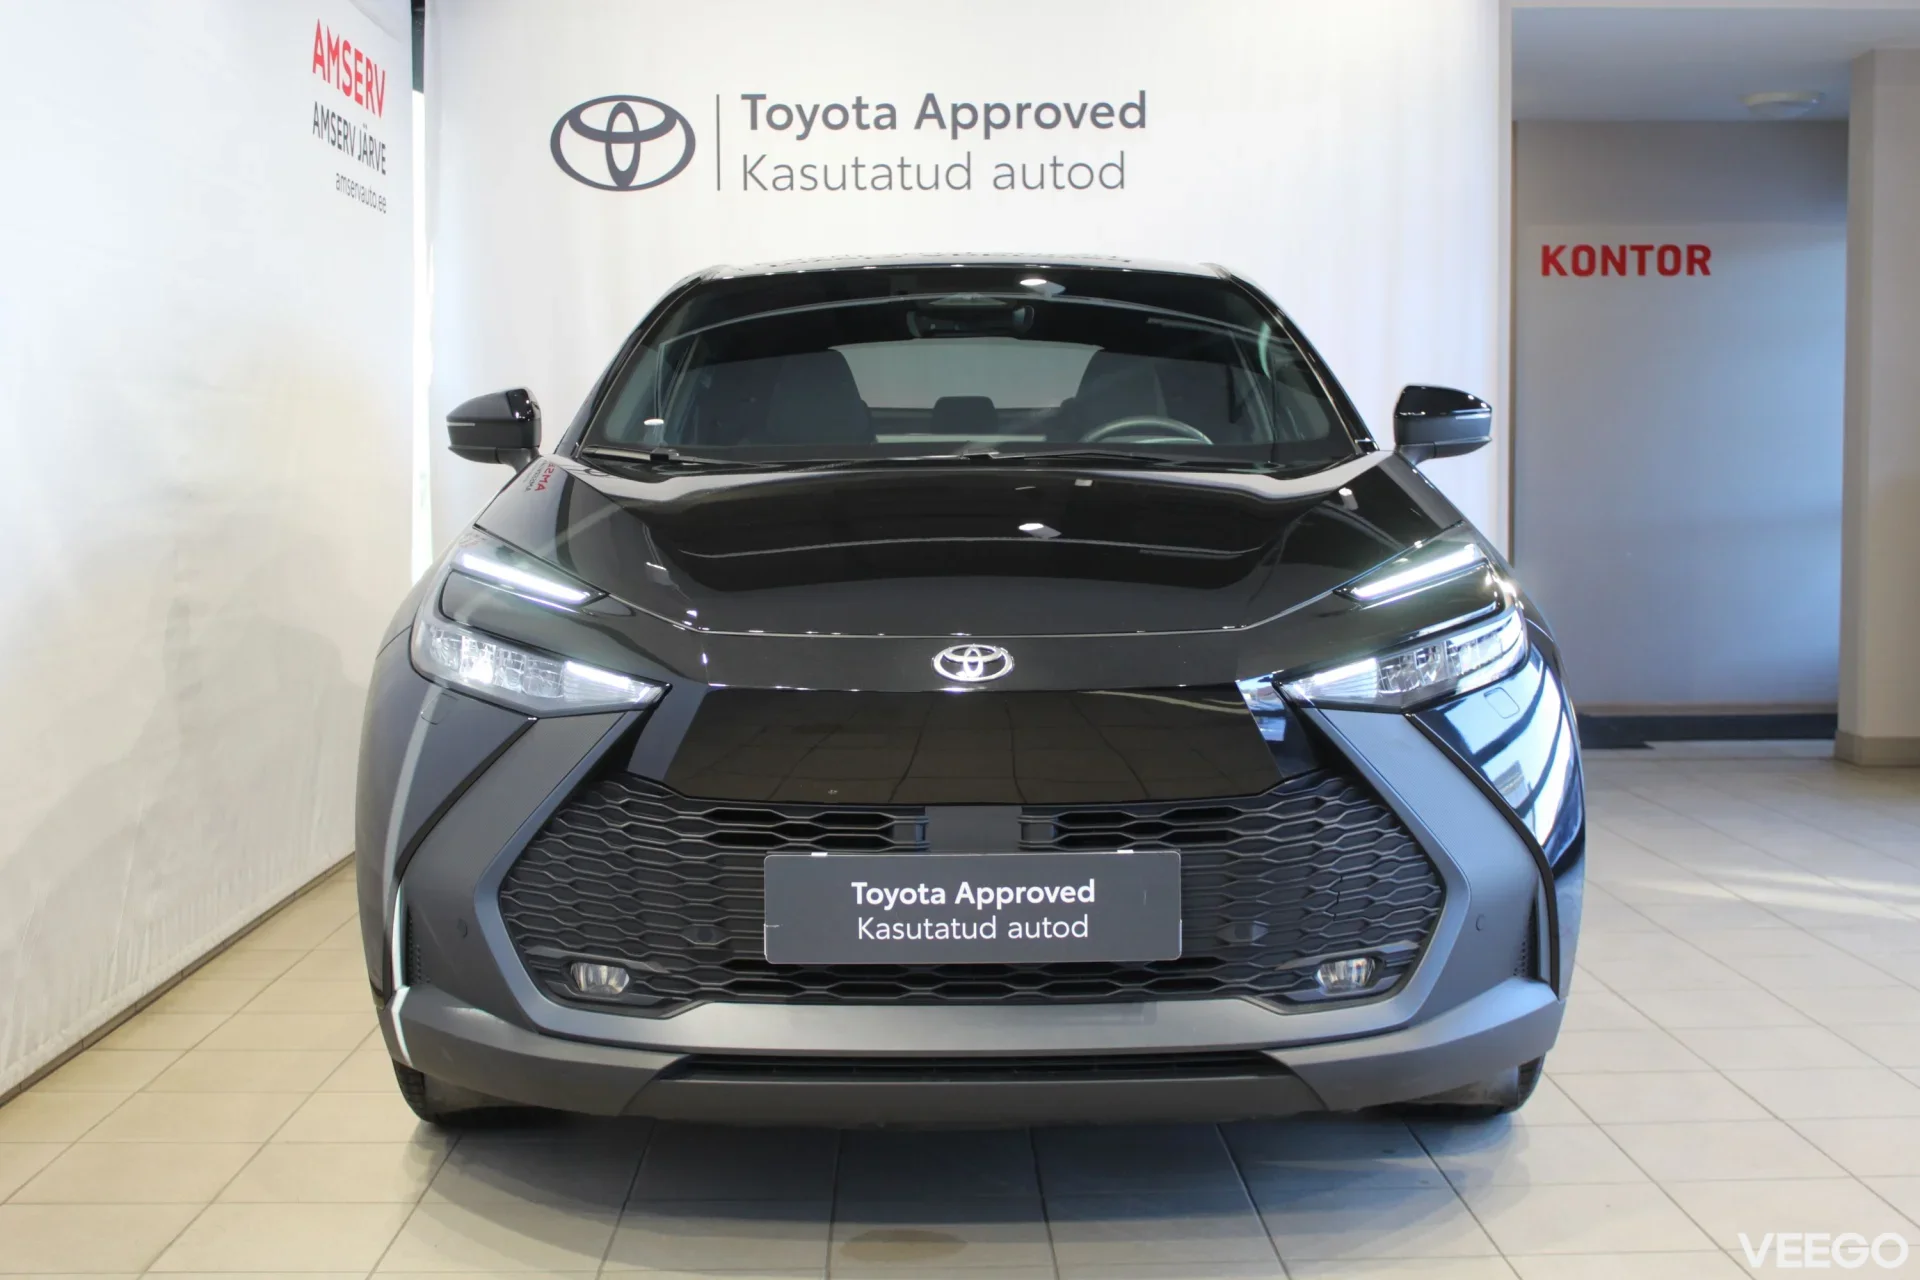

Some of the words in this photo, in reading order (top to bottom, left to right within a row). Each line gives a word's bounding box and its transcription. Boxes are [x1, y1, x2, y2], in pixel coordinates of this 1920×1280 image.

[312, 18, 386, 119] AMSERV
[741, 94, 897, 141] Toyota
[914, 90, 1147, 140] Approved
[312, 101, 356, 157] AMSERV
[357, 123, 386, 175] JÄRVE
[742, 151, 972, 191] Kasutatud
[992, 150, 1125, 190] autod
[335, 172, 387, 214] amservauto.ee
[1540, 243, 1712, 277] KONTOR
[851, 881, 946, 910] Toyota
[955, 879, 1096, 910] Approved
[858, 914, 997, 940] Kasutatud
[1007, 914, 1089, 939] autod
